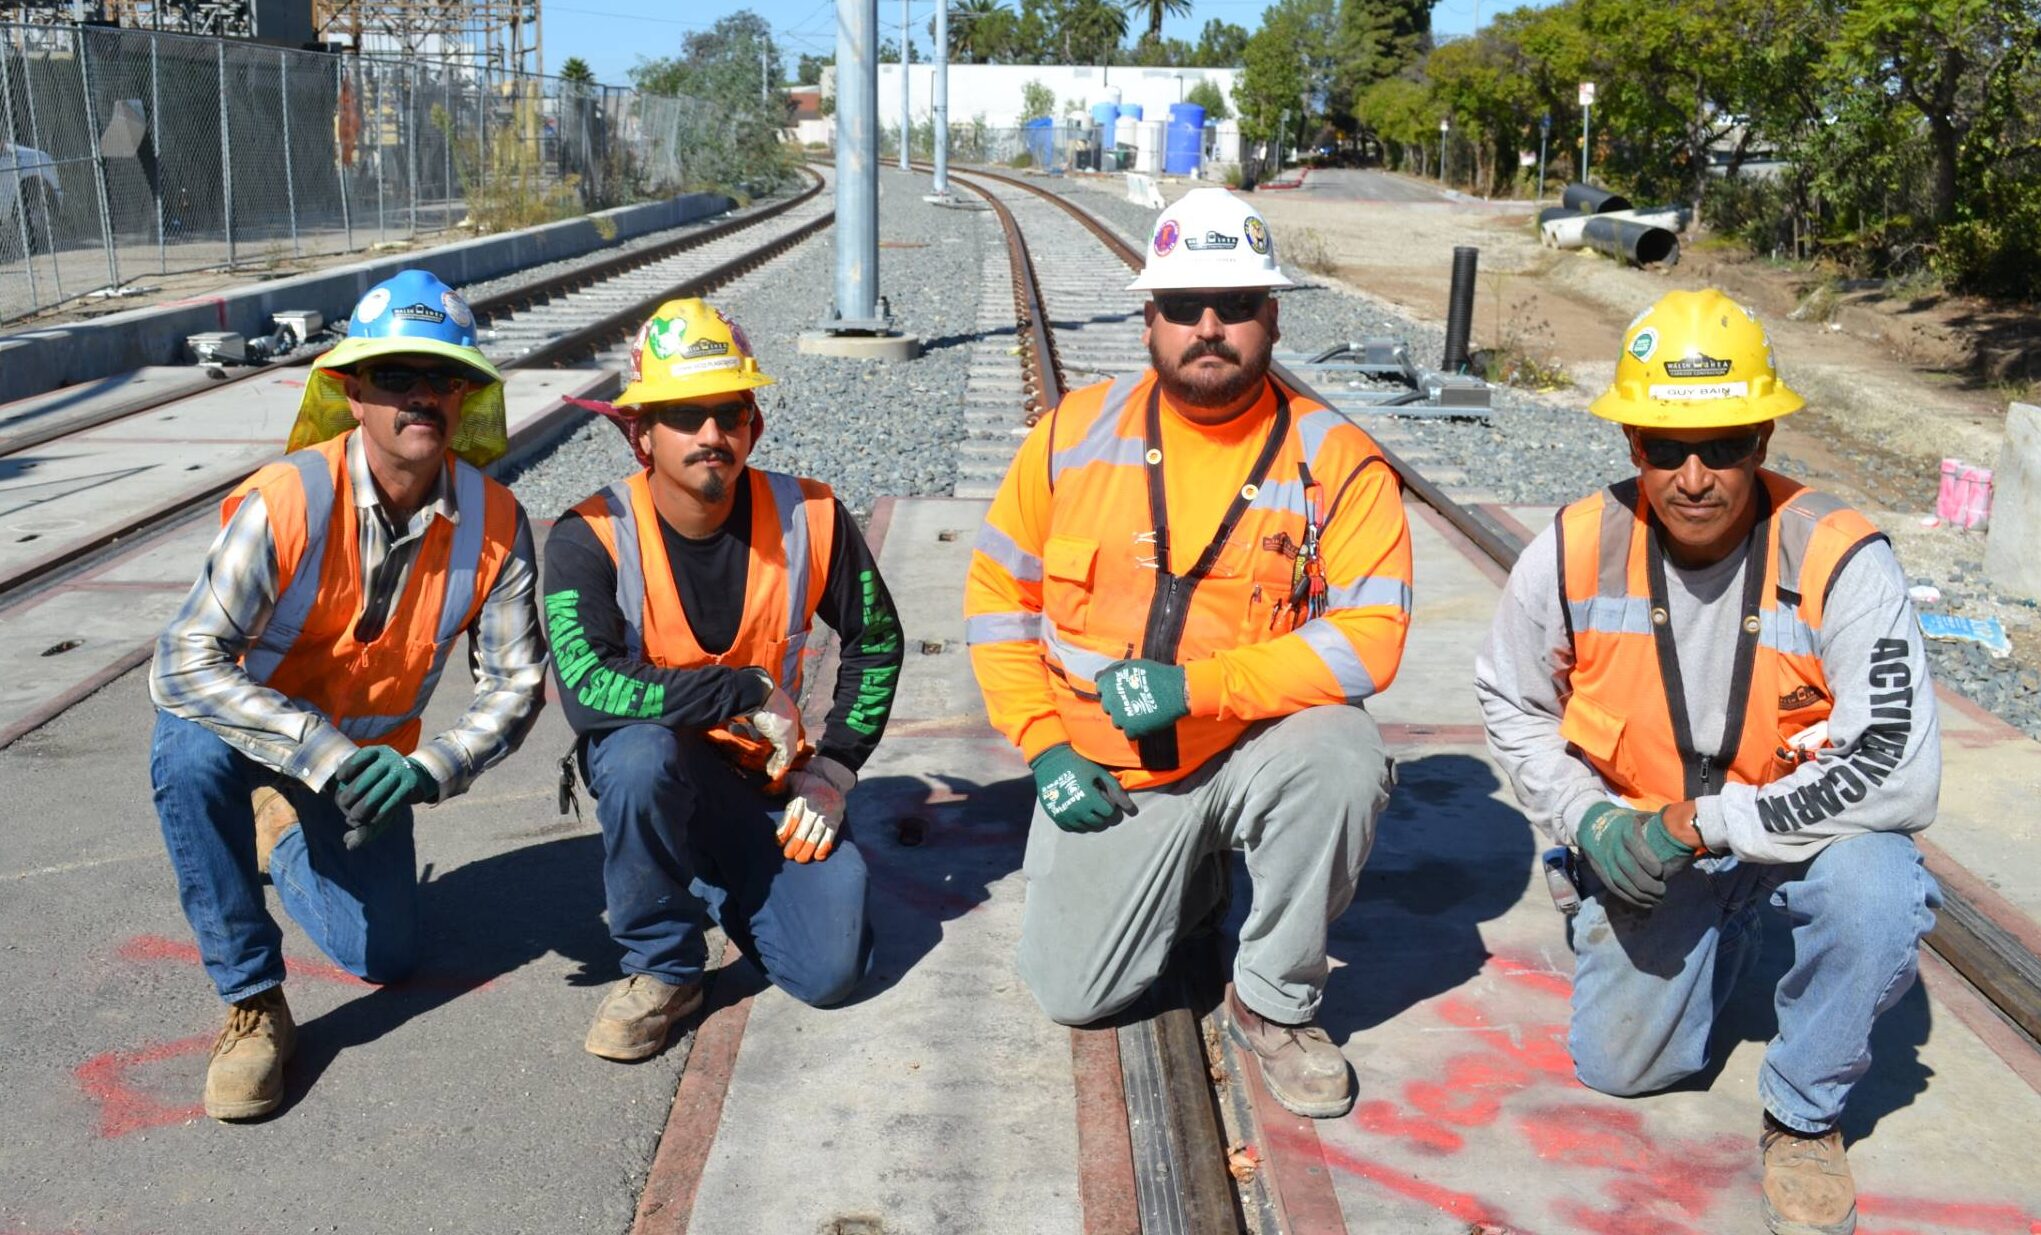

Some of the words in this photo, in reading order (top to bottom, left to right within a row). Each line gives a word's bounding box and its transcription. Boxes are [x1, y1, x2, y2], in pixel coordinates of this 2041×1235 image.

[1700, 387, 1731, 396] BAIN
[544, 589, 600, 689] WALSH
[578, 666, 664, 719] SHEA
[1851, 637, 1914, 788] ACTIVELY
